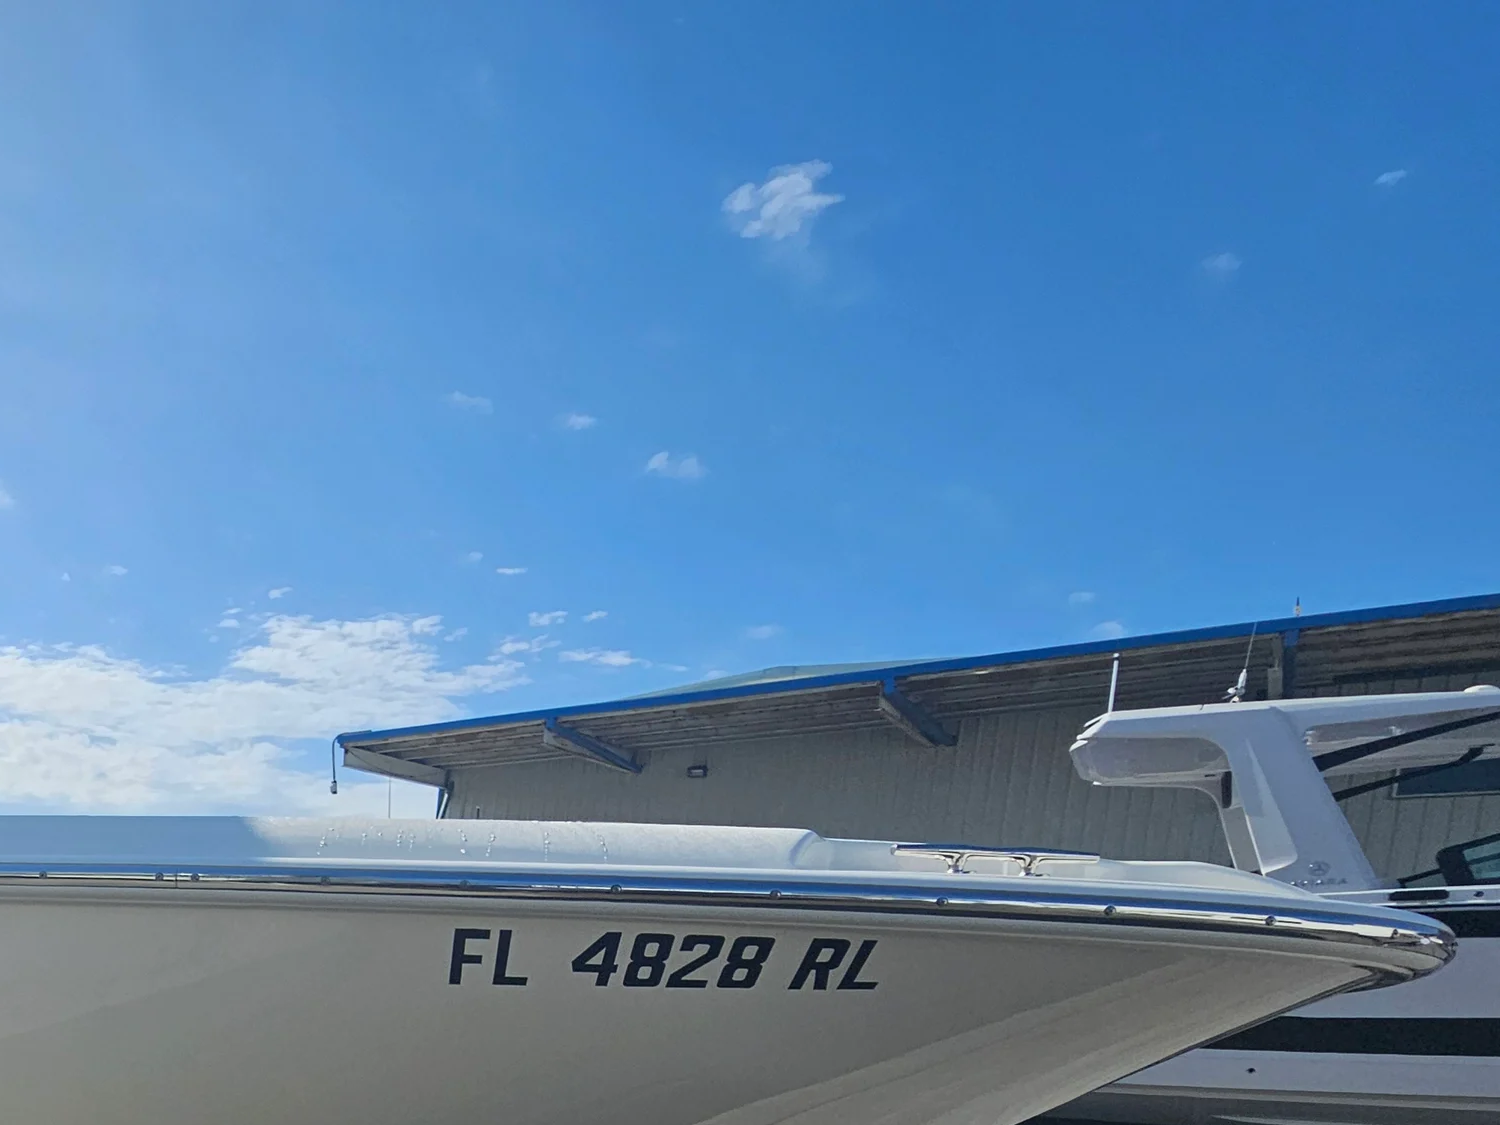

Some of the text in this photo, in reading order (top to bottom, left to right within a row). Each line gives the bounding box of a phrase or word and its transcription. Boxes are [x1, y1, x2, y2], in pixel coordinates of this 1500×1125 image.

[449, 928, 878, 991] FL 4828 RL
